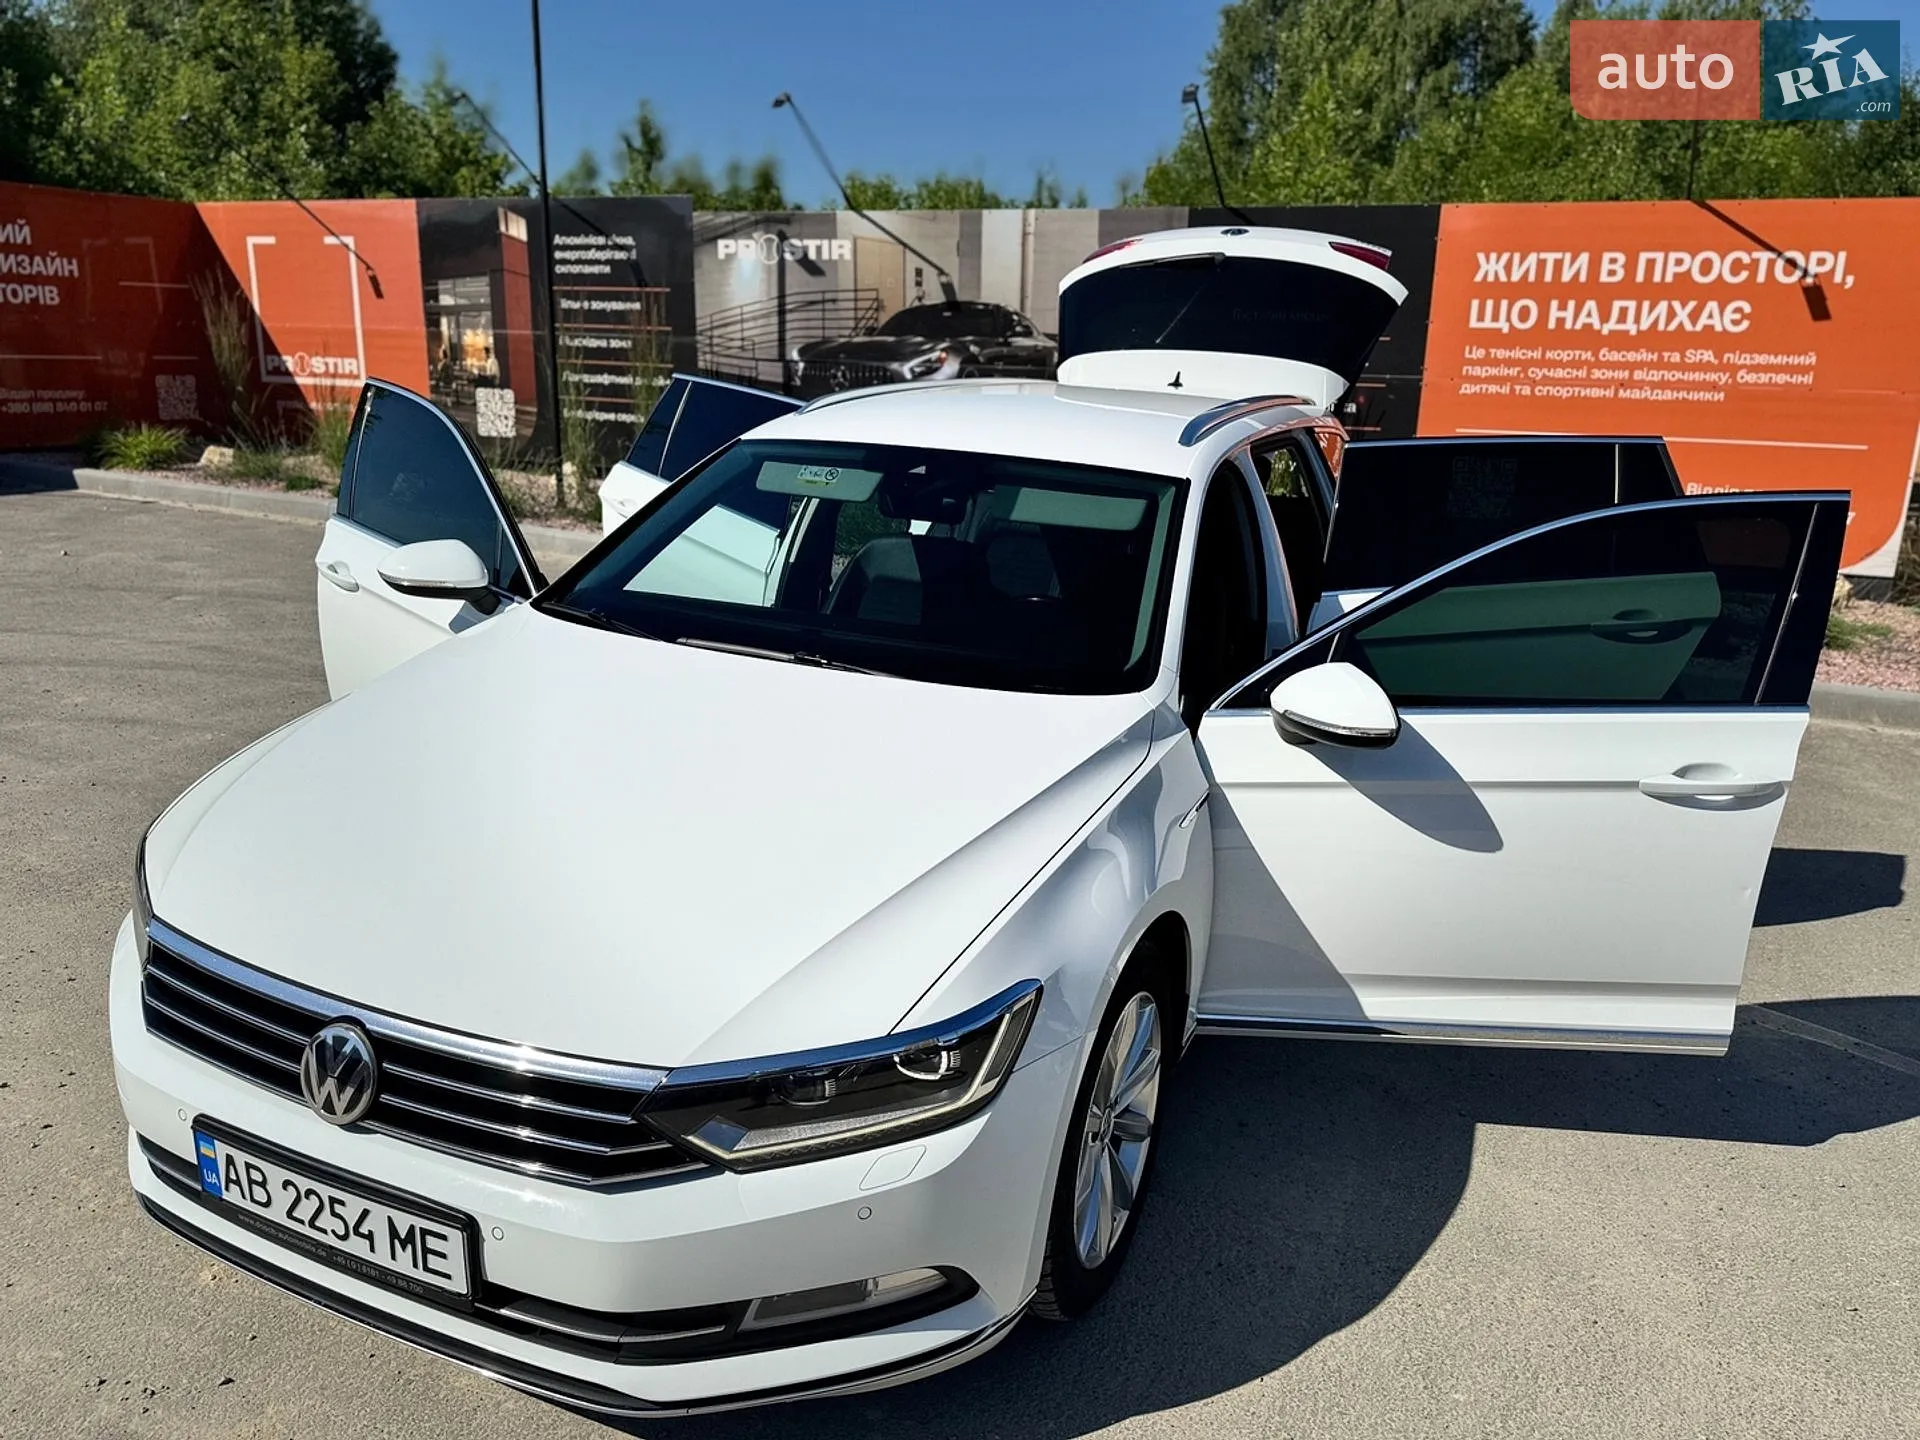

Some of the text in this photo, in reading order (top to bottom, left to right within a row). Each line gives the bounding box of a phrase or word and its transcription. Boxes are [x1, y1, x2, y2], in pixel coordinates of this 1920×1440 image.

[1473, 251, 1855, 289] ЖИТИ В ПРОСТОРІ,
[1468, 299, 1752, 335] ЩО НАДИХАЄ
[1464, 345, 1817, 366] Це тенісні корти, басейн та SPA, підземний
[1462, 364, 1813, 385] паркінг, сучасні зони відпочинку, безпечні
[1459, 382, 1725, 402] дитячі та спортивні майданчики
[203, 1168, 219, 1186] UA
[225, 1152, 272, 1208] AB
[281, 1178, 376, 1254] 2254
[386, 1214, 452, 1281] ME
